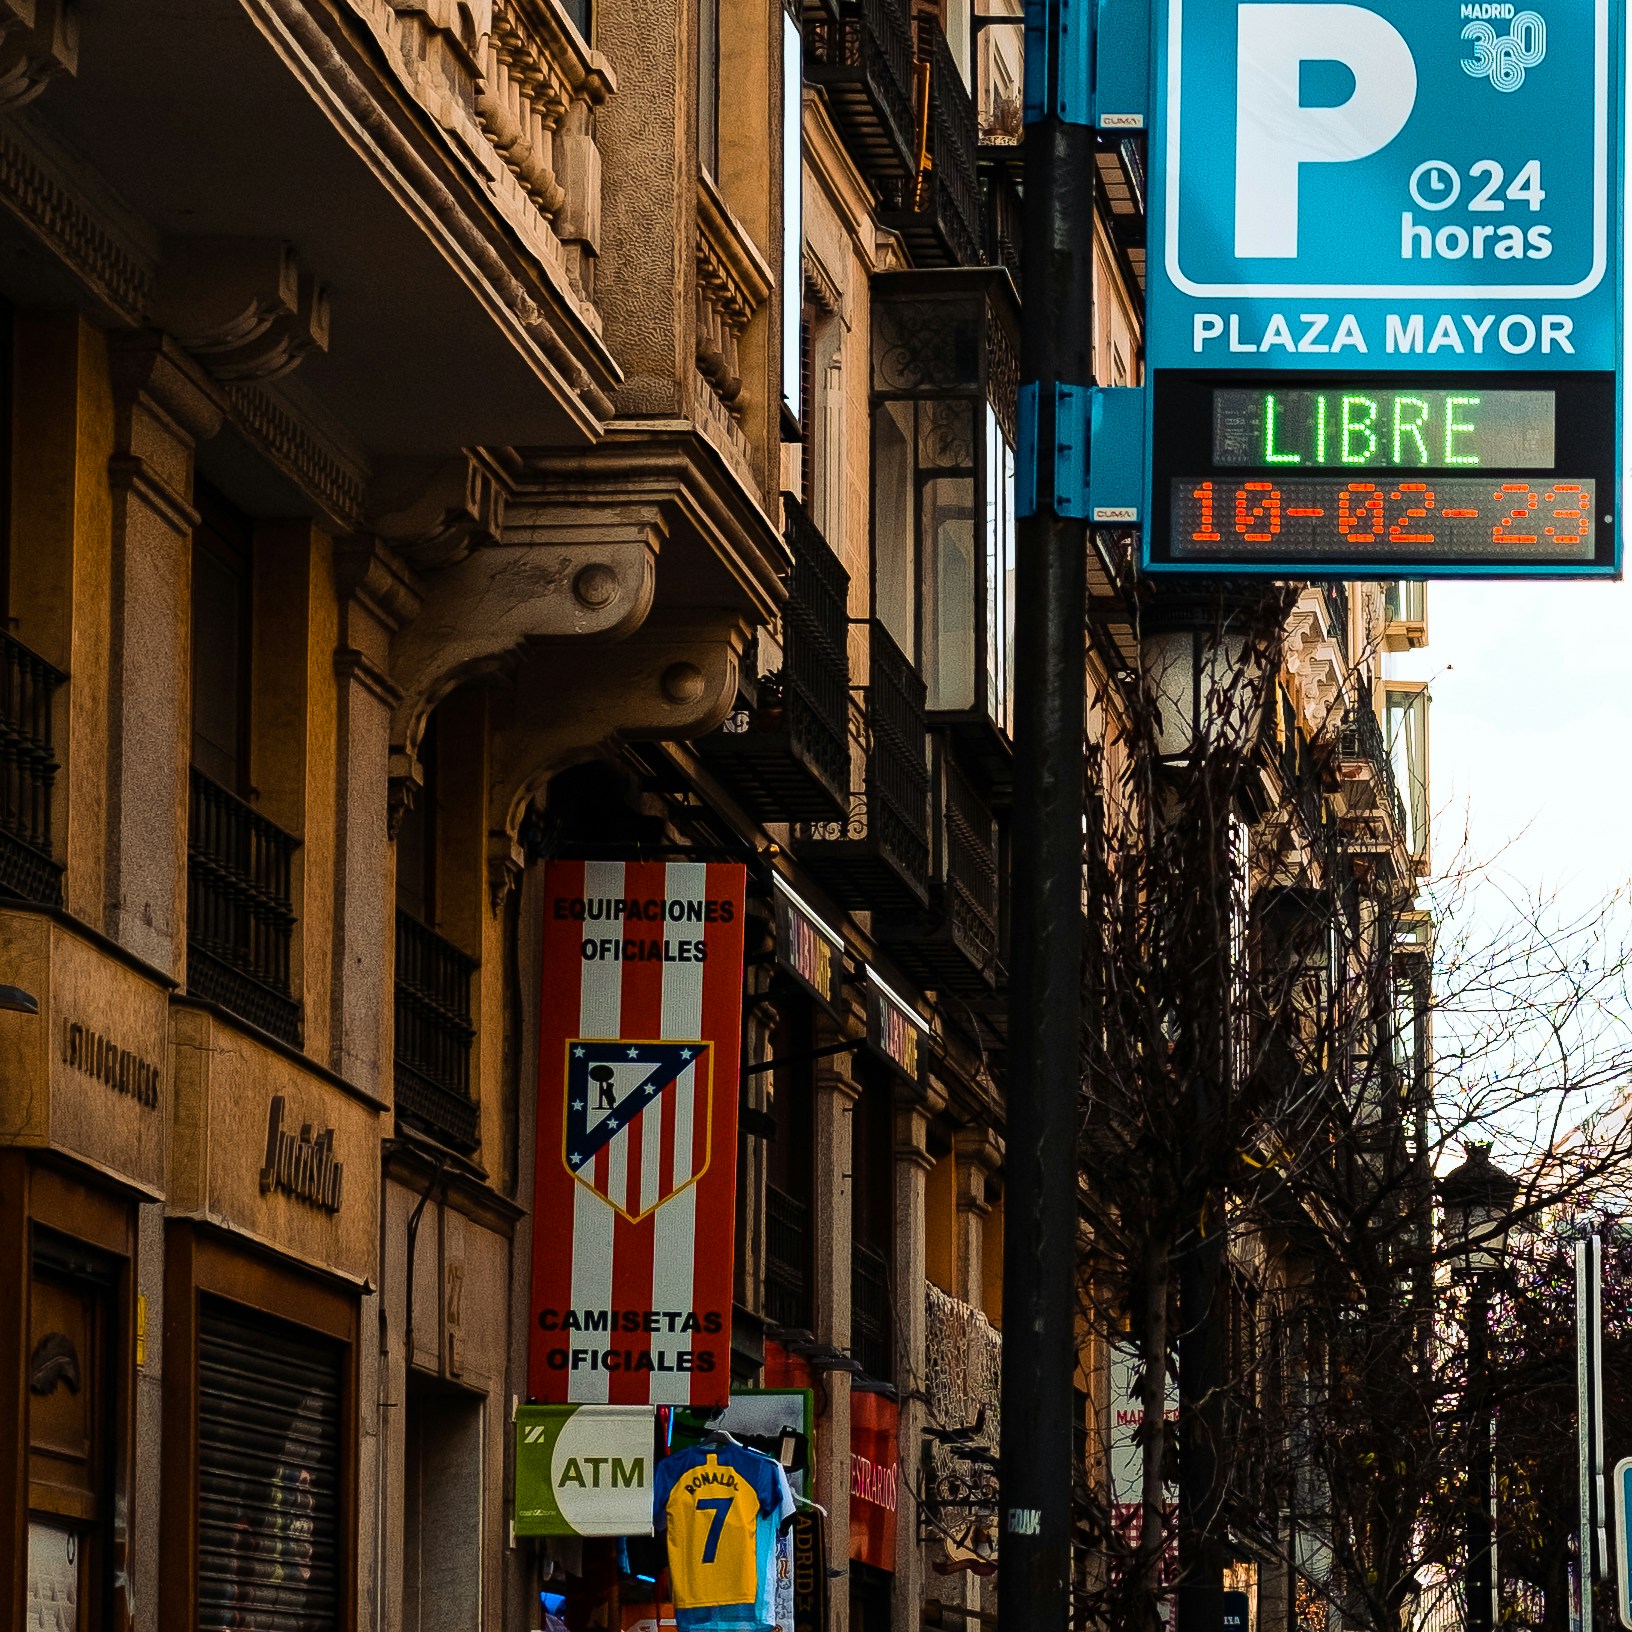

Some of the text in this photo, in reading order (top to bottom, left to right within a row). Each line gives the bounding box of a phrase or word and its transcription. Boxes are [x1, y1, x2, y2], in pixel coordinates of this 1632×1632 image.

[1460, 2, 1515, 20] MADRID
[1234, 3, 1418, 259] P
[1467, 159, 1546, 212] 24
[1401, 211, 1554, 261] horas
[1193, 313, 1576, 355] PLAZA MAYOR
[1263, 395, 1481, 465] LIBRE
[1192, 481, 1589, 544] 10-02-23
[552, 898, 735, 924] EQUIPACIONES
[580, 939, 709, 963] OFICIALES
[538, 1308, 723, 1334] CAMISETAS
[546, 1348, 716, 1373] OFICIALES
[557, 1457, 645, 1489] ATM
[695, 1497, 735, 1565] 7
